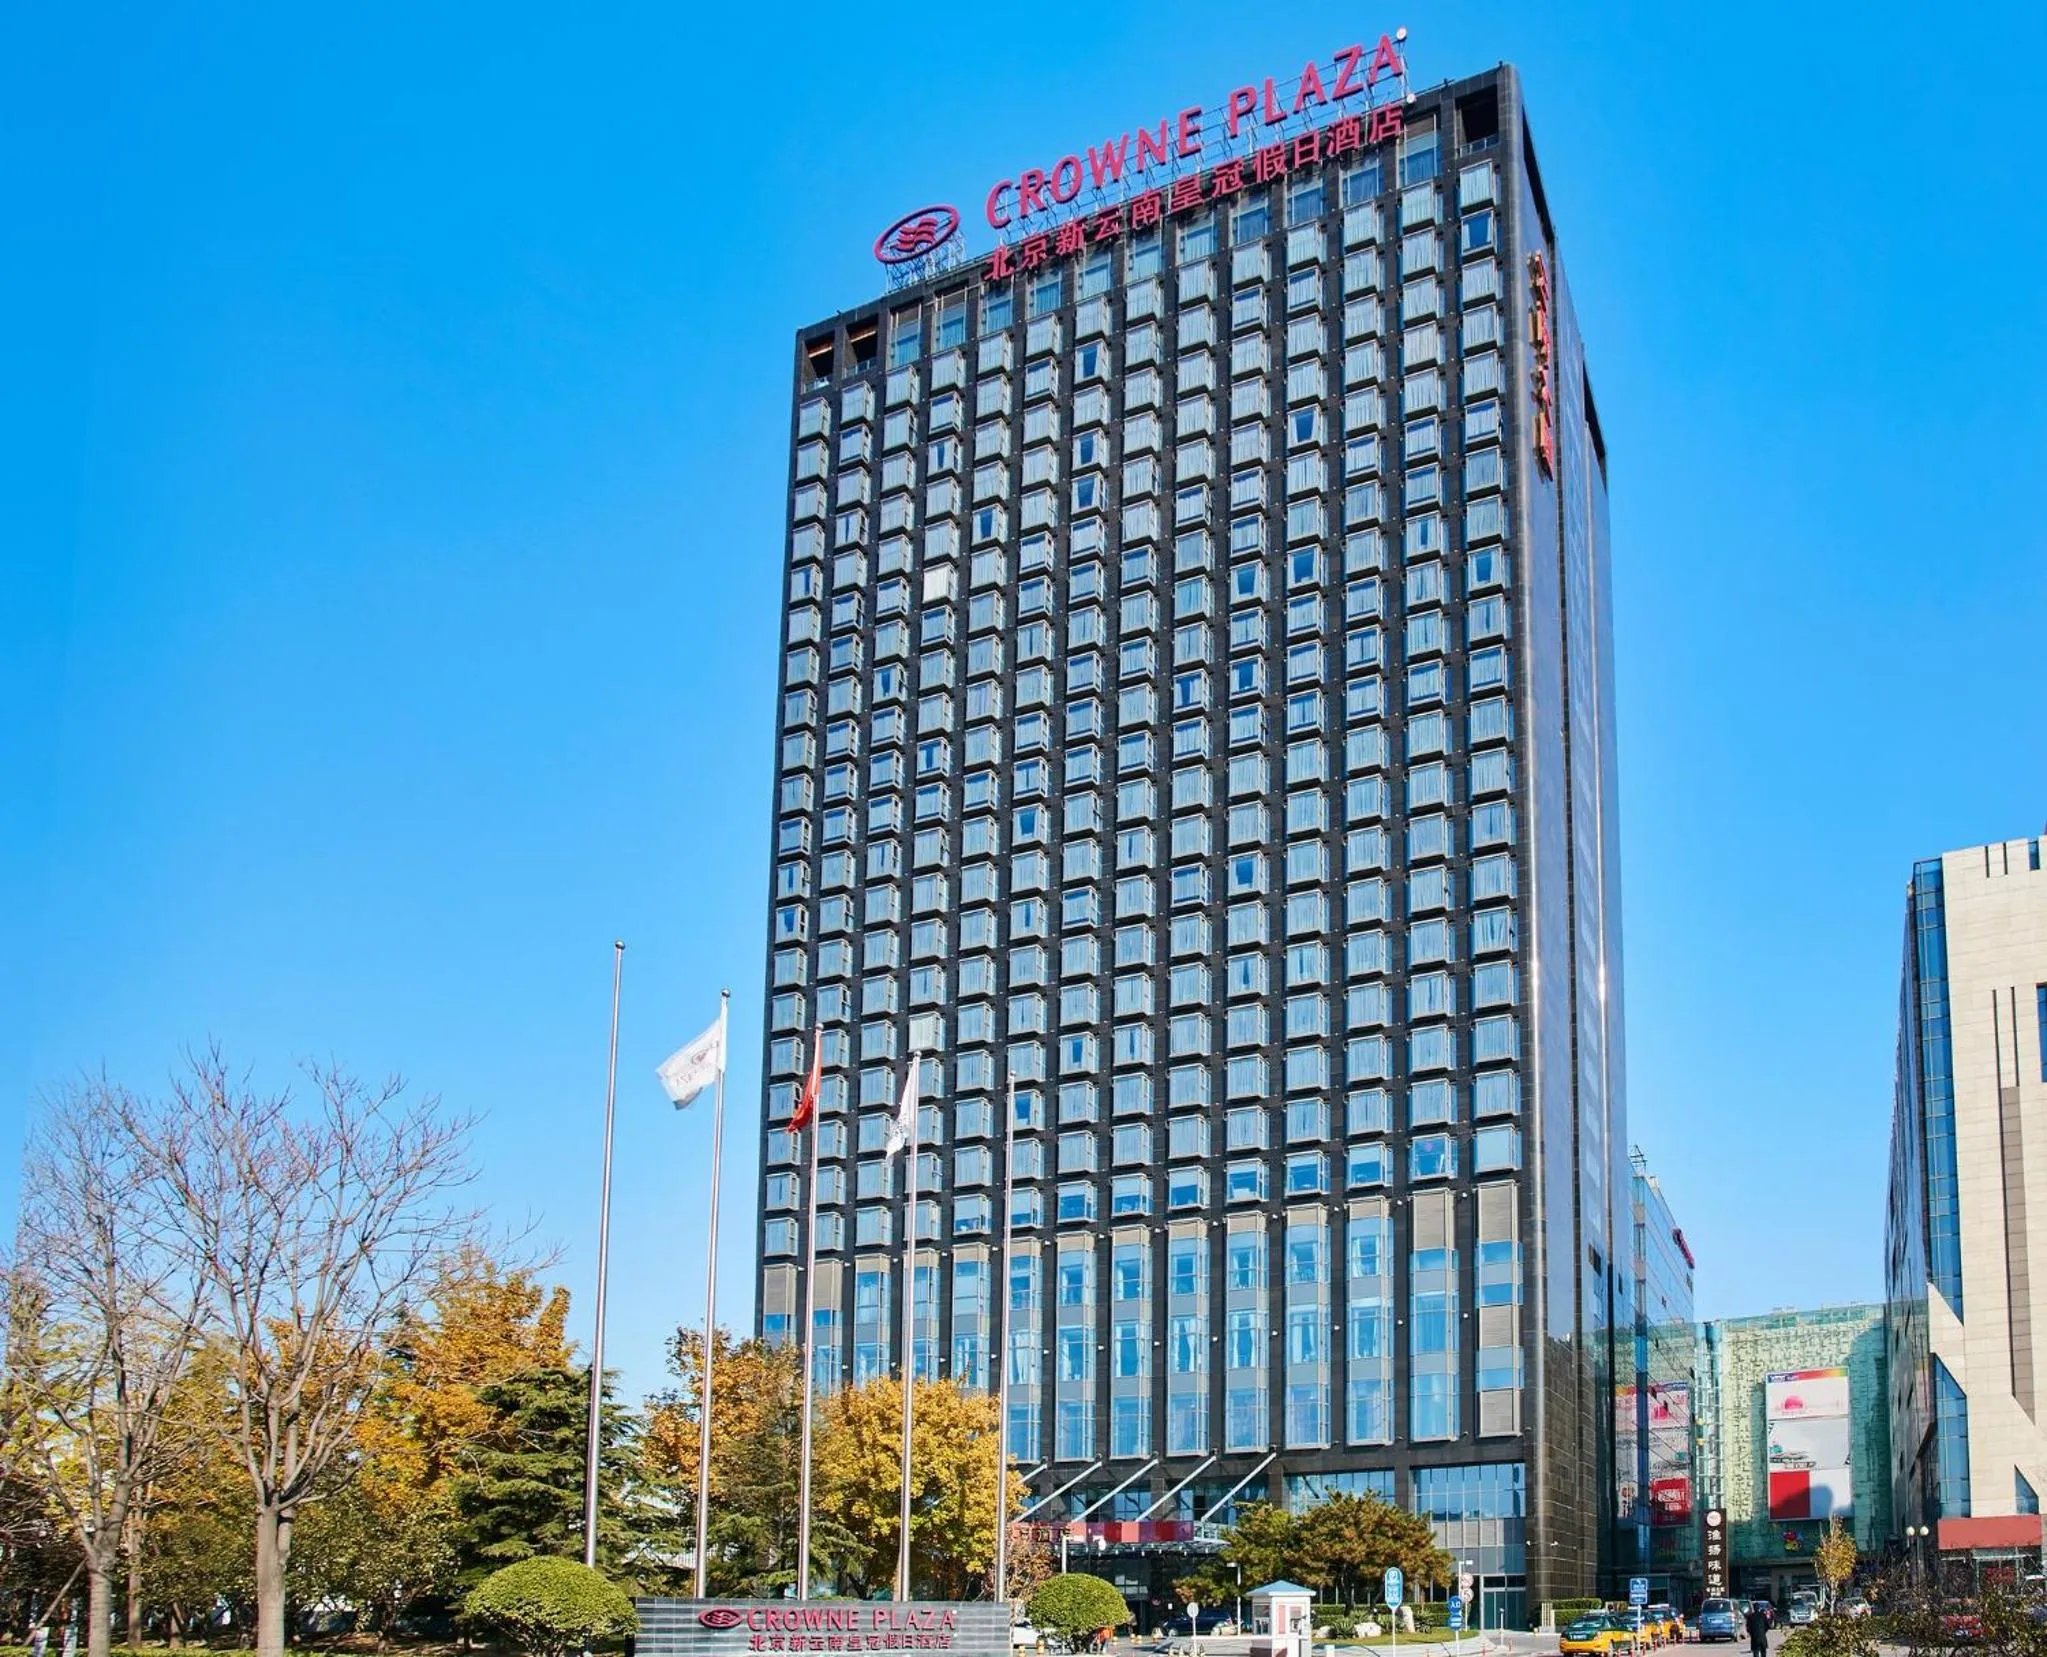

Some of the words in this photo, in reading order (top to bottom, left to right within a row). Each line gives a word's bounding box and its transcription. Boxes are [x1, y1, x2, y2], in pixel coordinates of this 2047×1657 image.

[983, 103, 1404, 281] 北京新云南皇冠假日酒店
[985, 107, 1202, 229] CROWNE
[1227, 33, 1404, 137] PLAZA
[747, 1607, 859, 1631] CROWNE
[872, 1608, 955, 1631] PLAZA
